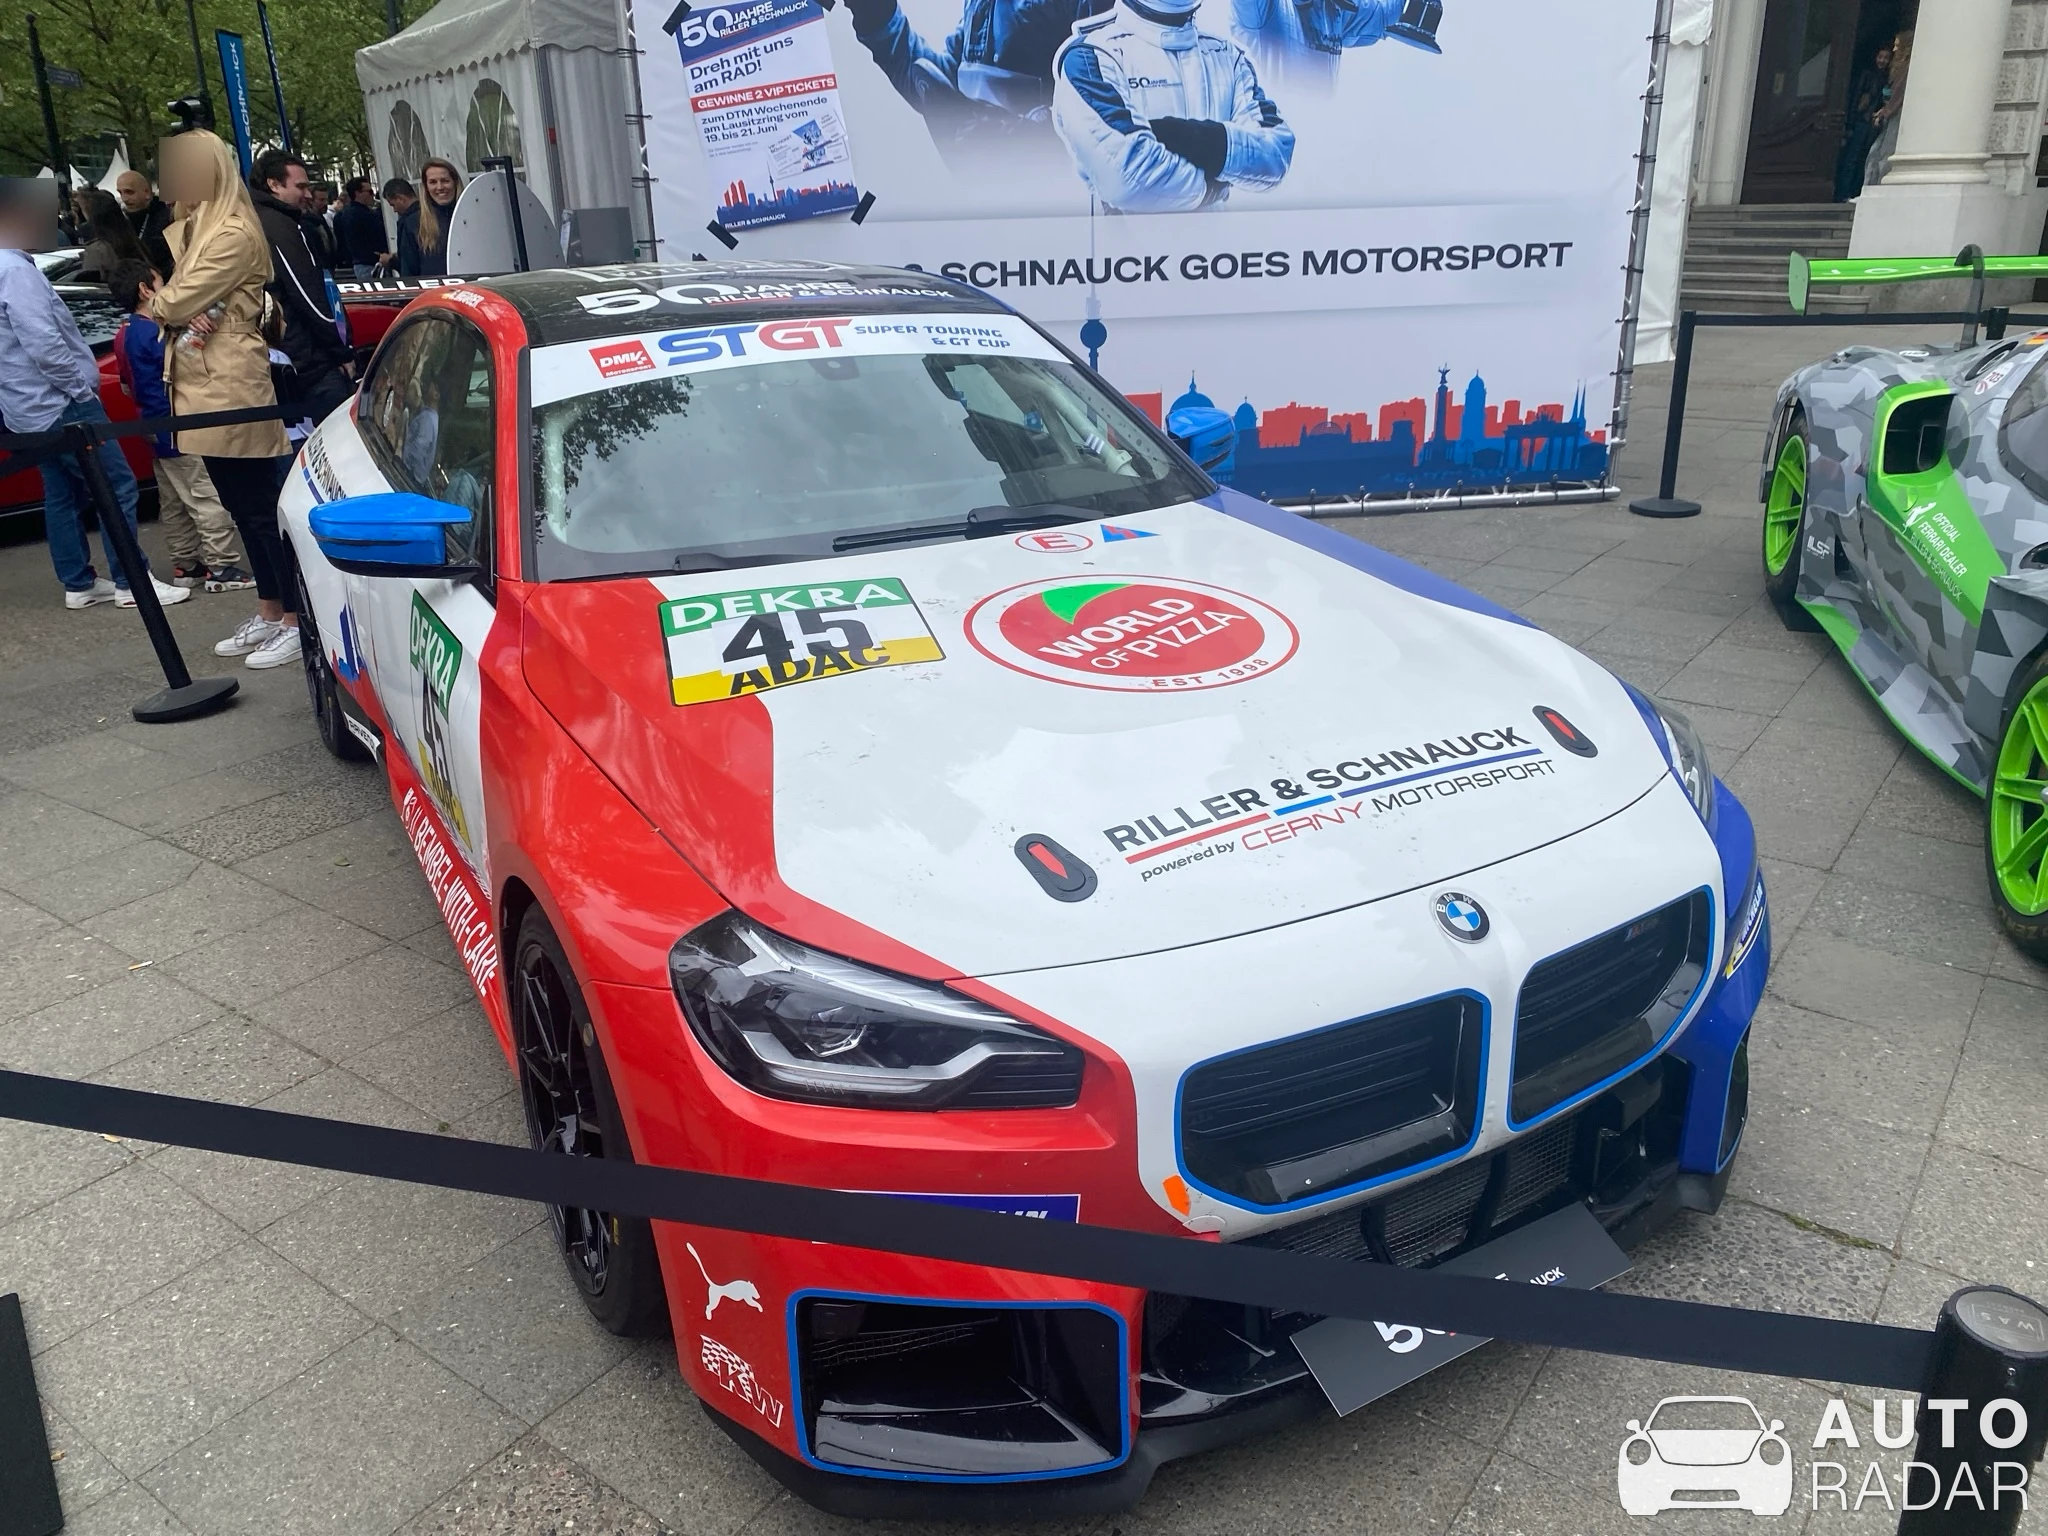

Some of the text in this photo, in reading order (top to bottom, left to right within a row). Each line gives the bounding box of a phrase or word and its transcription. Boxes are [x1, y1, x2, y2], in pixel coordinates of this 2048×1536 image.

[681, 9, 733, 47] 50
[720, 0, 808, 37] RILLER & SCHNAUCK
[733, 1, 774, 24] JAHRE
[690, 37, 794, 80] Dreh mit uns
[694, 59, 762, 93] am RAD!
[1128, 77, 1150, 89] 50
[697, 77, 835, 109] GEWINNE 2 VIP TICKETS
[701, 96, 828, 125] zum DTM Wochenende
[704, 124, 721, 134] am
[722, 113, 784, 131] Lausitzring
[784, 110, 809, 120] vom
[705, 124, 779, 143] 19. bis 21. Juni
[725, 219, 746, 229] RILLER
[752, 213, 787, 225] SCHNAUCK
[941, 242, 1573, 288] SCHNAUCK GOES MOTORSPORT
[575, 283, 741, 315] 50
[704, 288, 955, 305] RILLER & SCHNAUCK
[741, 281, 857, 294] JAHRE
[659, 318, 853, 366] STGT
[854, 325, 1003, 338] SUPER TOURING
[931, 337, 1011, 349] & GT CUP
[1032, 535, 1078, 549] E
[1932, 512, 1961, 543] OFFICIAL
[1918, 522, 1967, 578] FERRARI DEALER
[671, 584, 903, 629] DEKRA
[722, 604, 887, 670] 45
[1038, 598, 1195, 659] WORLD
[1090, 609, 1248, 669] OF PIZZA
[411, 605, 455, 709] DEKRA
[730, 647, 890, 695] ADAC
[1151, 658, 1269, 687] EST 1998
[1102, 726, 1532, 853] RILLER & SCHNAUCK
[1140, 760, 1556, 883] powered by CERNY MOTORSPORT
